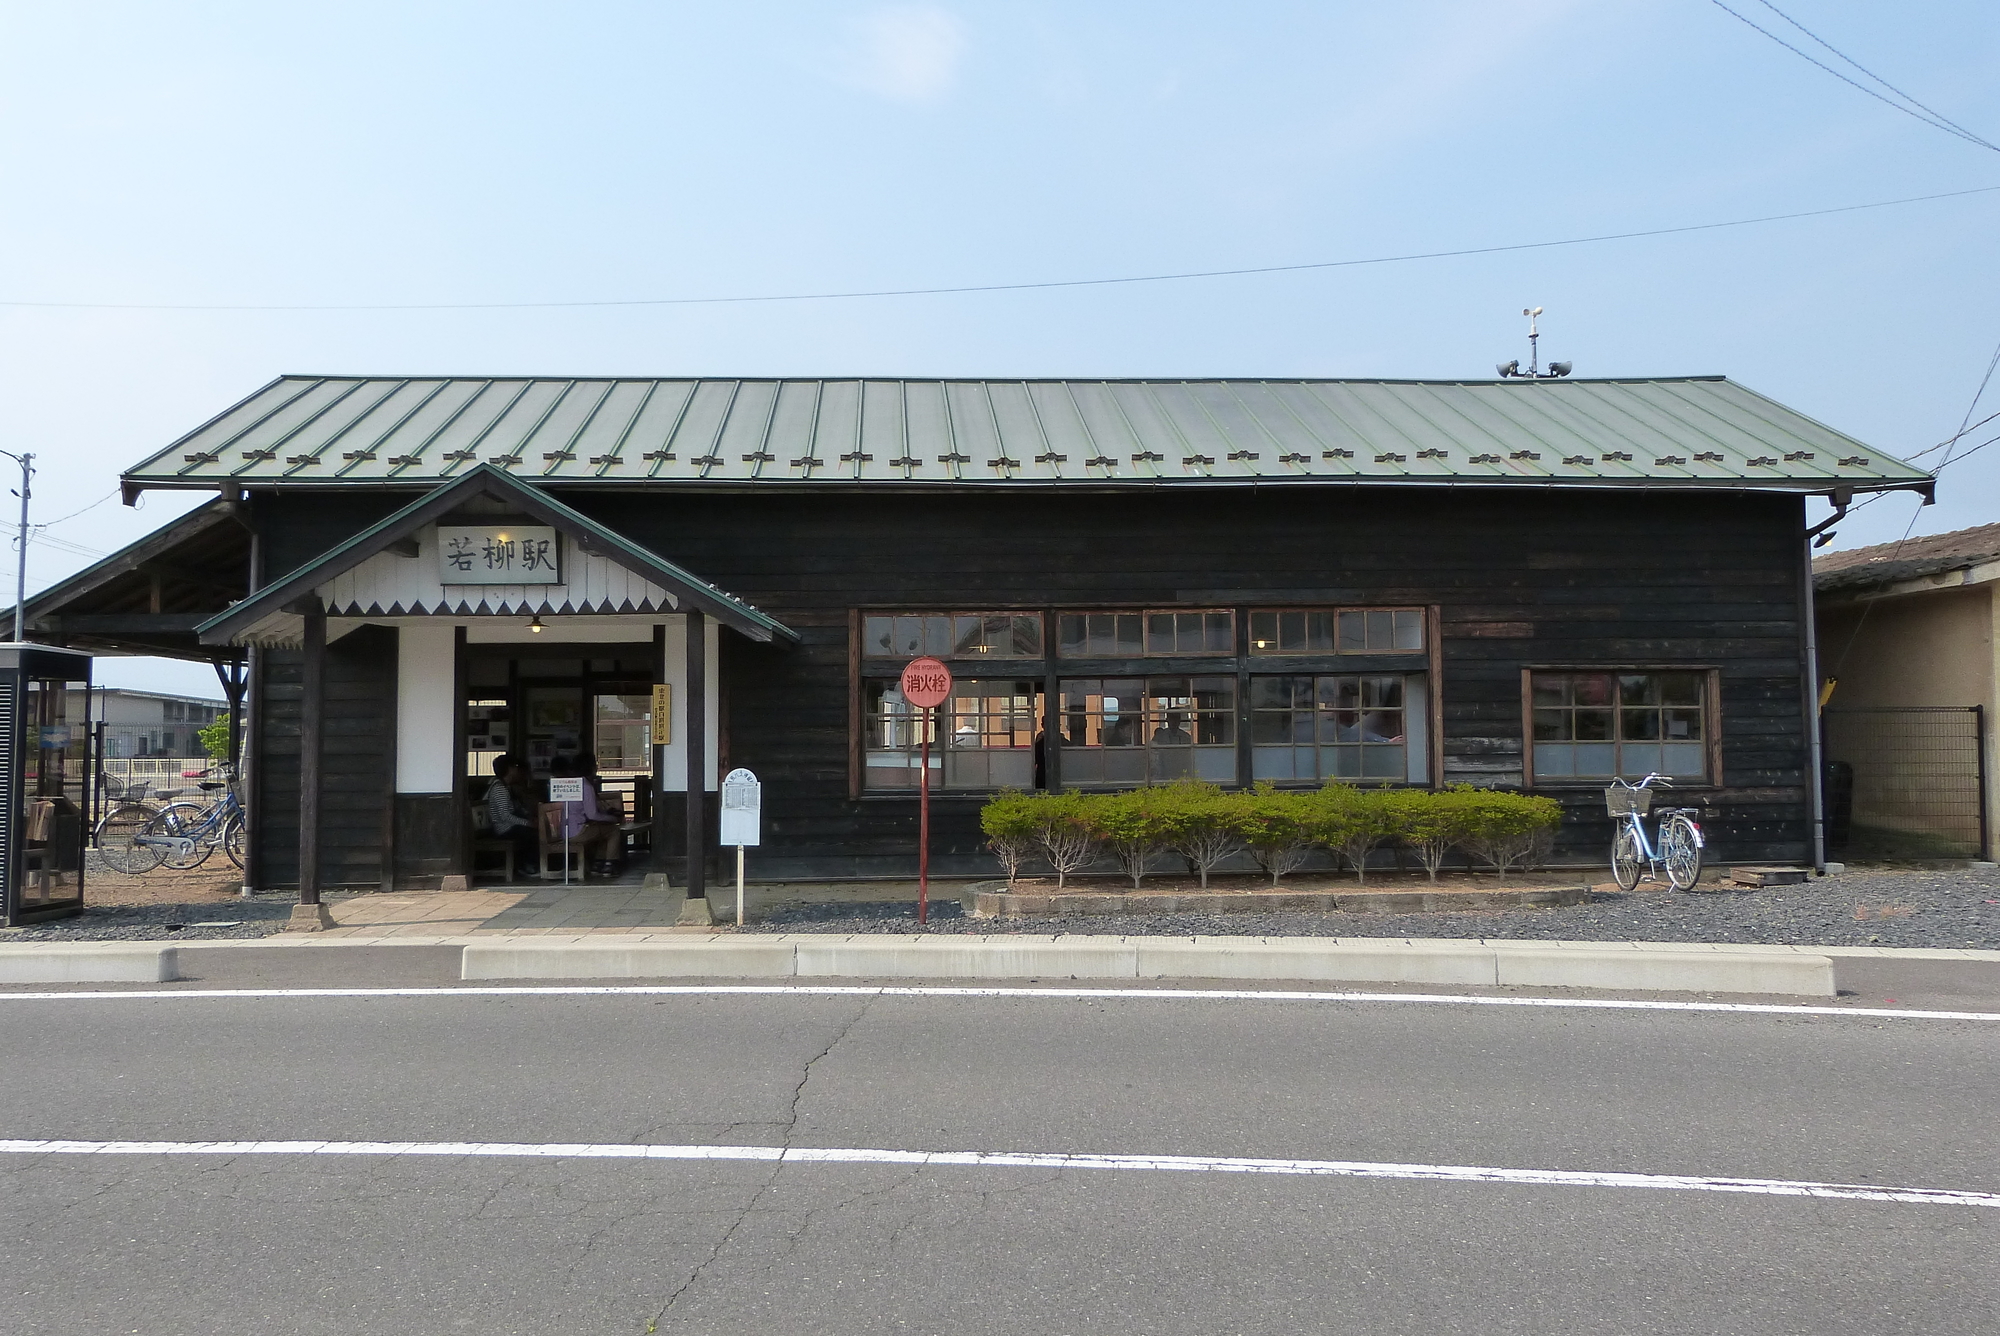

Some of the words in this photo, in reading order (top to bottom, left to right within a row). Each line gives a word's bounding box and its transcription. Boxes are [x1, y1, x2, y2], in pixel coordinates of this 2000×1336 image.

[447, 537, 556, 571] 若柳駅
[907, 674, 946, 692] 消火栓
